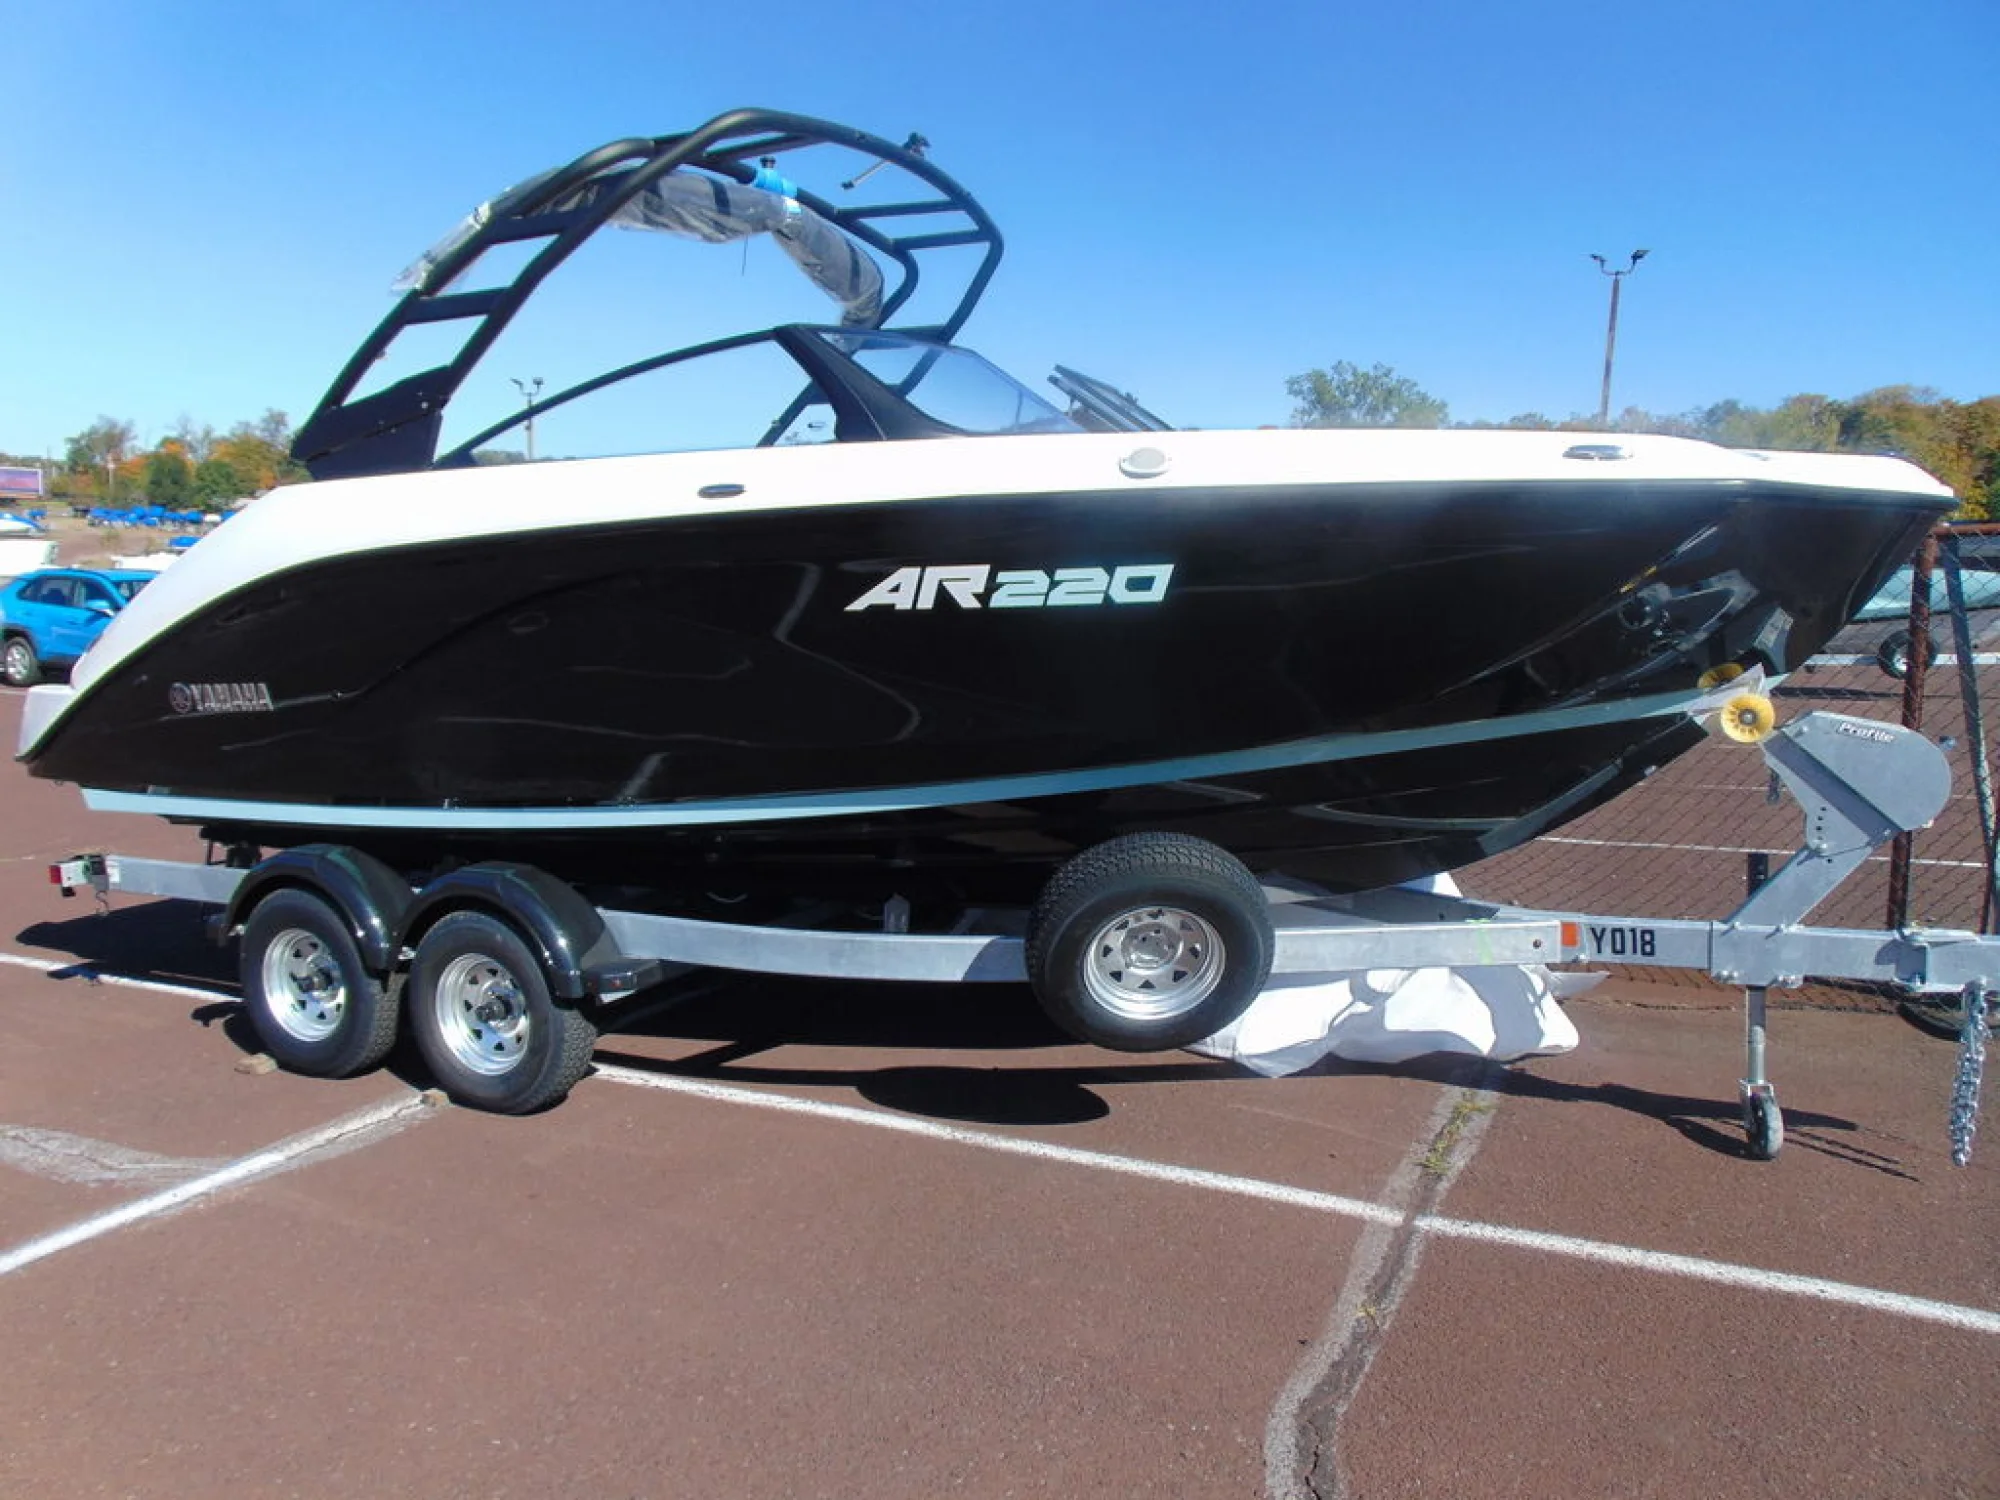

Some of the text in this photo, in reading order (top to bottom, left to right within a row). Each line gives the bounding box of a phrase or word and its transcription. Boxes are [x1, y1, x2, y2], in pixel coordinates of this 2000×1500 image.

[844, 564, 1174, 611] AR220
[190, 683, 274, 712] YAMAHA
[1838, 721, 1895, 743] Profile
[1590, 927, 1655, 957] Y018
